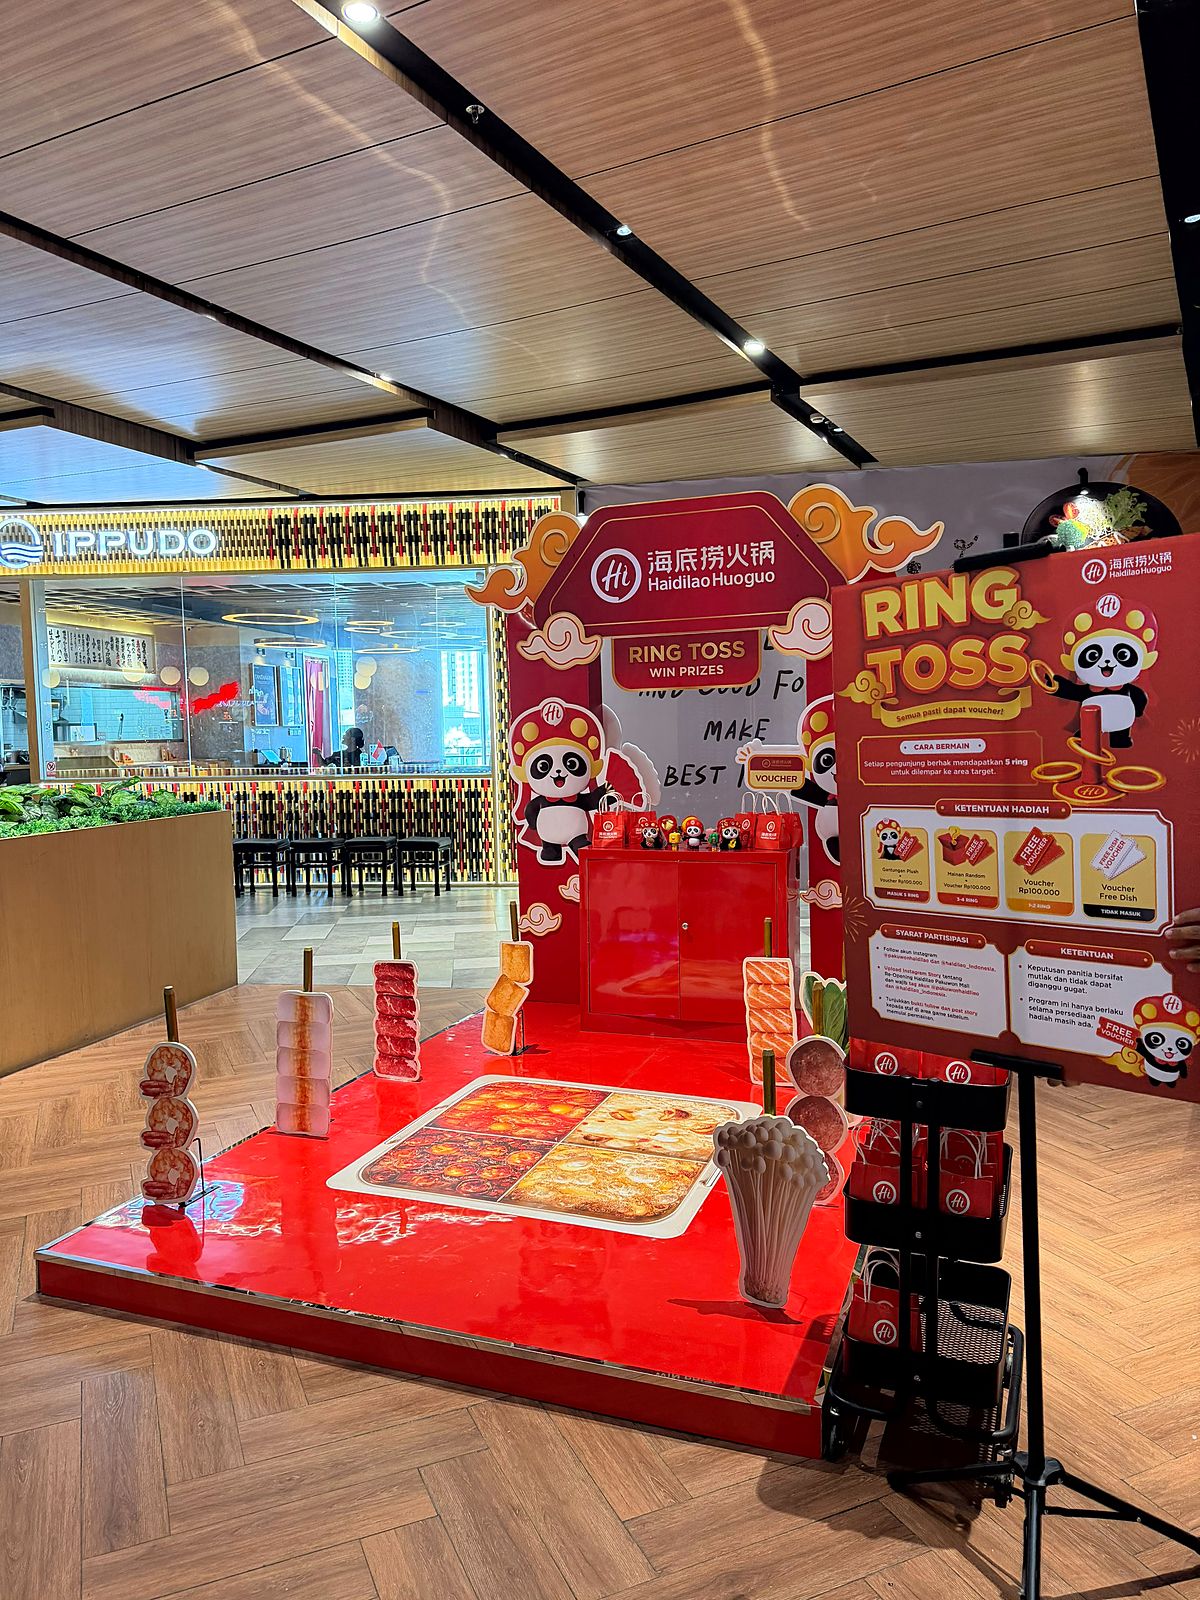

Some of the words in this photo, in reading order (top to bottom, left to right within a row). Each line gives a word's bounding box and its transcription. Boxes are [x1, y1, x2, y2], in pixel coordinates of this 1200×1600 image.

[53, 529, 217, 557] IPPUDO
[648, 540, 775, 575] 海底捞火锅
[1109, 551, 1172, 570] 海底捞火锅
[601, 559, 631, 592] Hi
[1087, 564, 1102, 579] Hi
[863, 569, 1018, 638] RING
[1100, 597, 1117, 613] Hi
[629, 644, 682, 664] RING
[688, 641, 745, 660] TOSS
[650, 667, 675, 678] WIN
[680, 665, 724, 677] PRIZES
[866, 634, 1028, 694] TOSS
[545, 704, 561, 721] Hi
[896, 712, 921, 723] Semua
[923, 707, 941, 718] pasti
[943, 706, 966, 717] dapat
[968, 706, 1004, 716] voucher!
[704, 718, 770, 742] MAKE
[936, 742, 970, 750] BERMAIN
[864, 760, 885, 768] Setiap
[886, 760, 926, 769] pengunjung
[927, 759, 951, 767] berhak
[952, 759, 1003, 768] mendapatkan
[1011, 758, 1028, 768] ring
[664, 764, 726, 787] BEST
[755, 774, 798, 783] VOUCHER
[911, 769, 942, 778] dilempar
[971, 768, 997, 777] target.
[954, 804, 1009, 813] KETENTUAN
[1012, 805, 1050, 814] HADIAH
[897, 836, 910, 853] FREE
[965, 839, 979, 857] FREE
[1020, 834, 1041, 860] FREE
[1025, 837, 1048, 867] VOUCHER
[1099, 850, 1110, 865] FREE
[1108, 837, 1119, 852] DISH
[1103, 840, 1126, 869] VOUCHER
[1023, 878, 1055, 888] Voucher
[1101, 883, 1135, 893] Voucher
[1018, 887, 1060, 897] Rp100.000
[1099, 892, 1118, 901] Free
[1120, 894, 1138, 902] Dish
[895, 929, 922, 939] SYARAT
[924, 931, 969, 944] PARTISIPASI
[1060, 947, 1114, 960] KETENTUAN
[884, 965, 902, 973] Upload
[942, 974, 963, 982] tentang
[1027, 963, 1066, 975] Keputusan
[1067, 967, 1093, 979] panitia
[1094, 970, 1124, 982] bersifat
[1027, 972, 1052, 981] mutlak
[1053, 975, 1068, 984] dan
[1069, 977, 1088, 986] tidak
[1090, 980, 1112, 990] dapat
[1027, 980, 1062, 992] diganggu
[1063, 985, 1088, 995] gugat.
[1028, 996, 1059, 1008] Program
[1060, 1000, 1070, 1008] ini
[1071, 1002, 1094, 1013] hanya
[1095, 1006, 1124, 1016] berlaku
[1165, 997, 1180, 1011] Hi
[1028, 1005, 1054, 1014] selama
[1055, 1008, 1096, 1021] persediaan
[1028, 1012, 1053, 1022] hadiah
[1054, 1016, 1076, 1026] masih
[1077, 1020, 1094, 1029] ada.
[1101, 1028, 1134, 1046] VOUCHER
[1106, 1022, 1132, 1039] FREE
[879, 1056, 893, 1071] Hi
[951, 1065, 966, 1080] Hi
[878, 1185, 891, 1199] Hi
[950, 1194, 965, 1208] Hi
[878, 1324, 892, 1339] Hi
